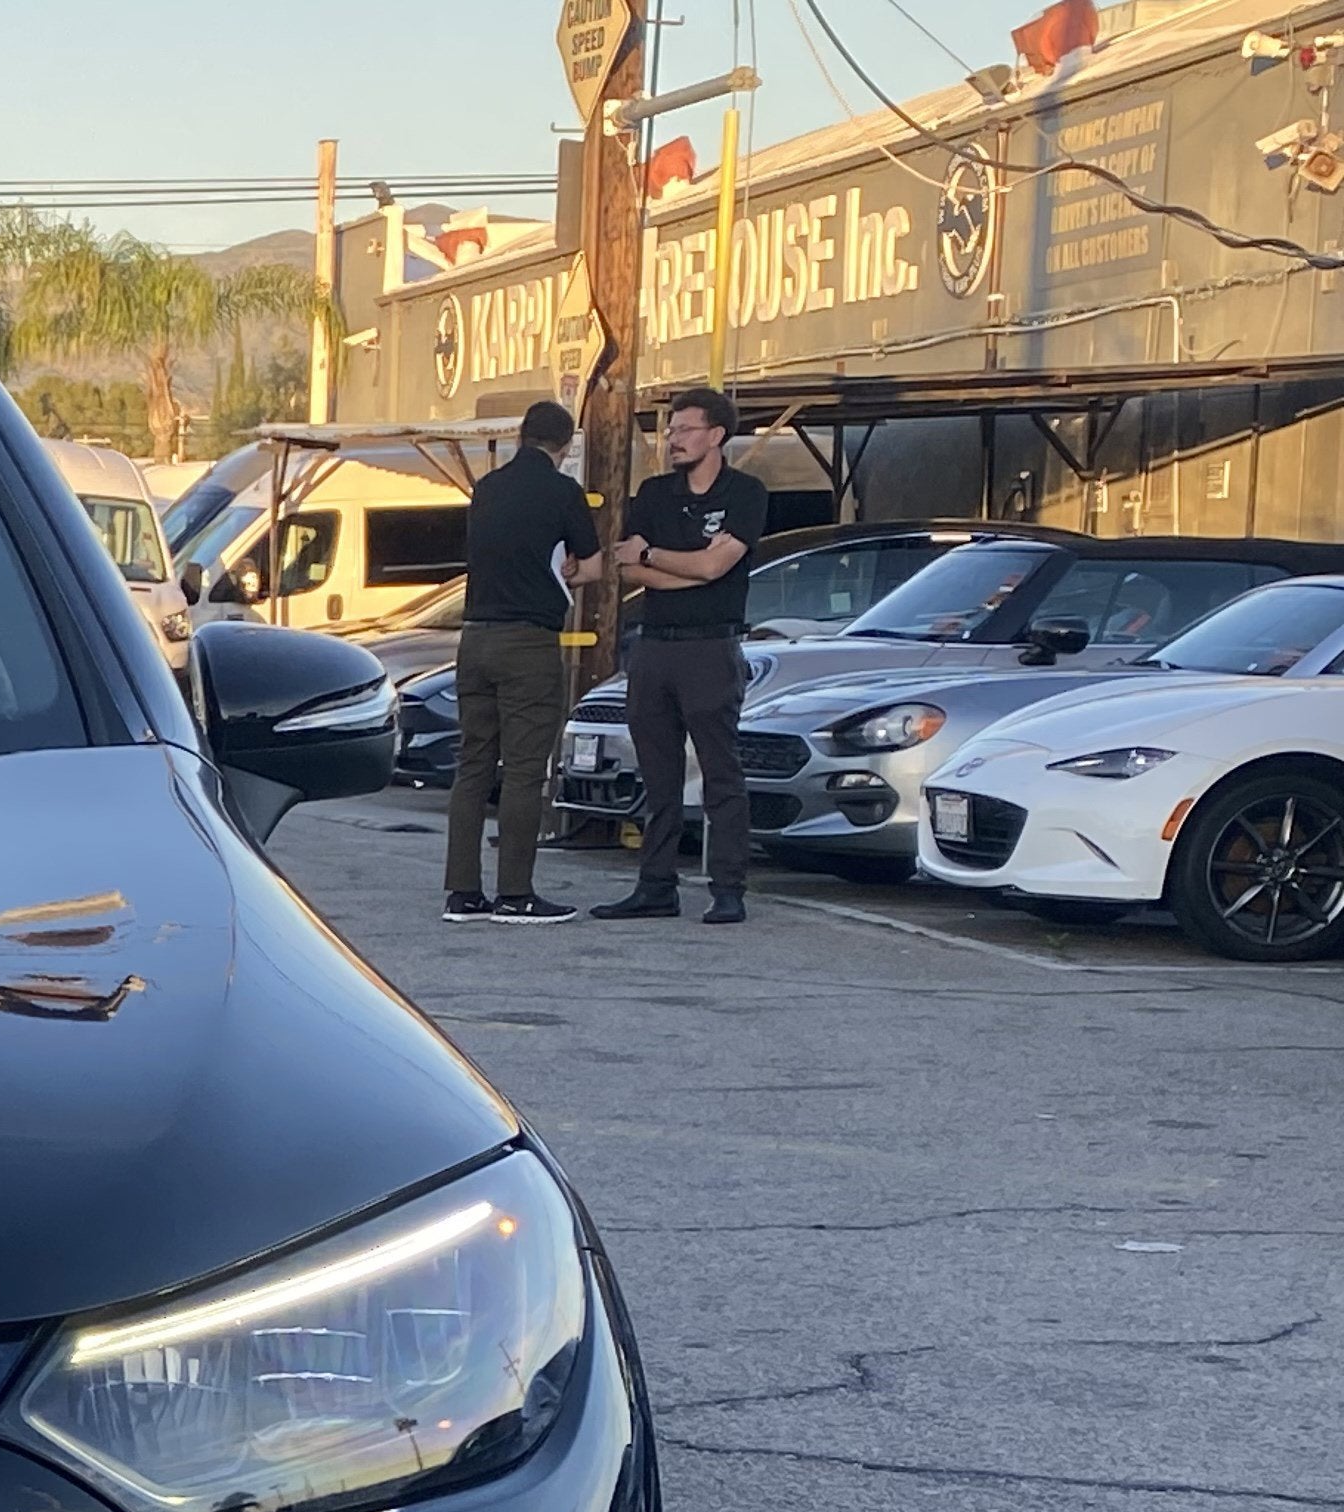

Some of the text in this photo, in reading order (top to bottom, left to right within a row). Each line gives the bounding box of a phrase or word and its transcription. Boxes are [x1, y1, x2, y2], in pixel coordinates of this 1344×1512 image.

[572, 26, 605, 55] SPEED
[1107, 101, 1164, 144] COMPANY
[1141, 142, 1158, 175] OF
[1062, 241, 1081, 271] ALL
[1081, 223, 1149, 267] CUSTOMERS
[471, 270, 568, 382] KARPL
[638, 194, 838, 350] AREHOUSE
[843, 186, 918, 304] Inc.
